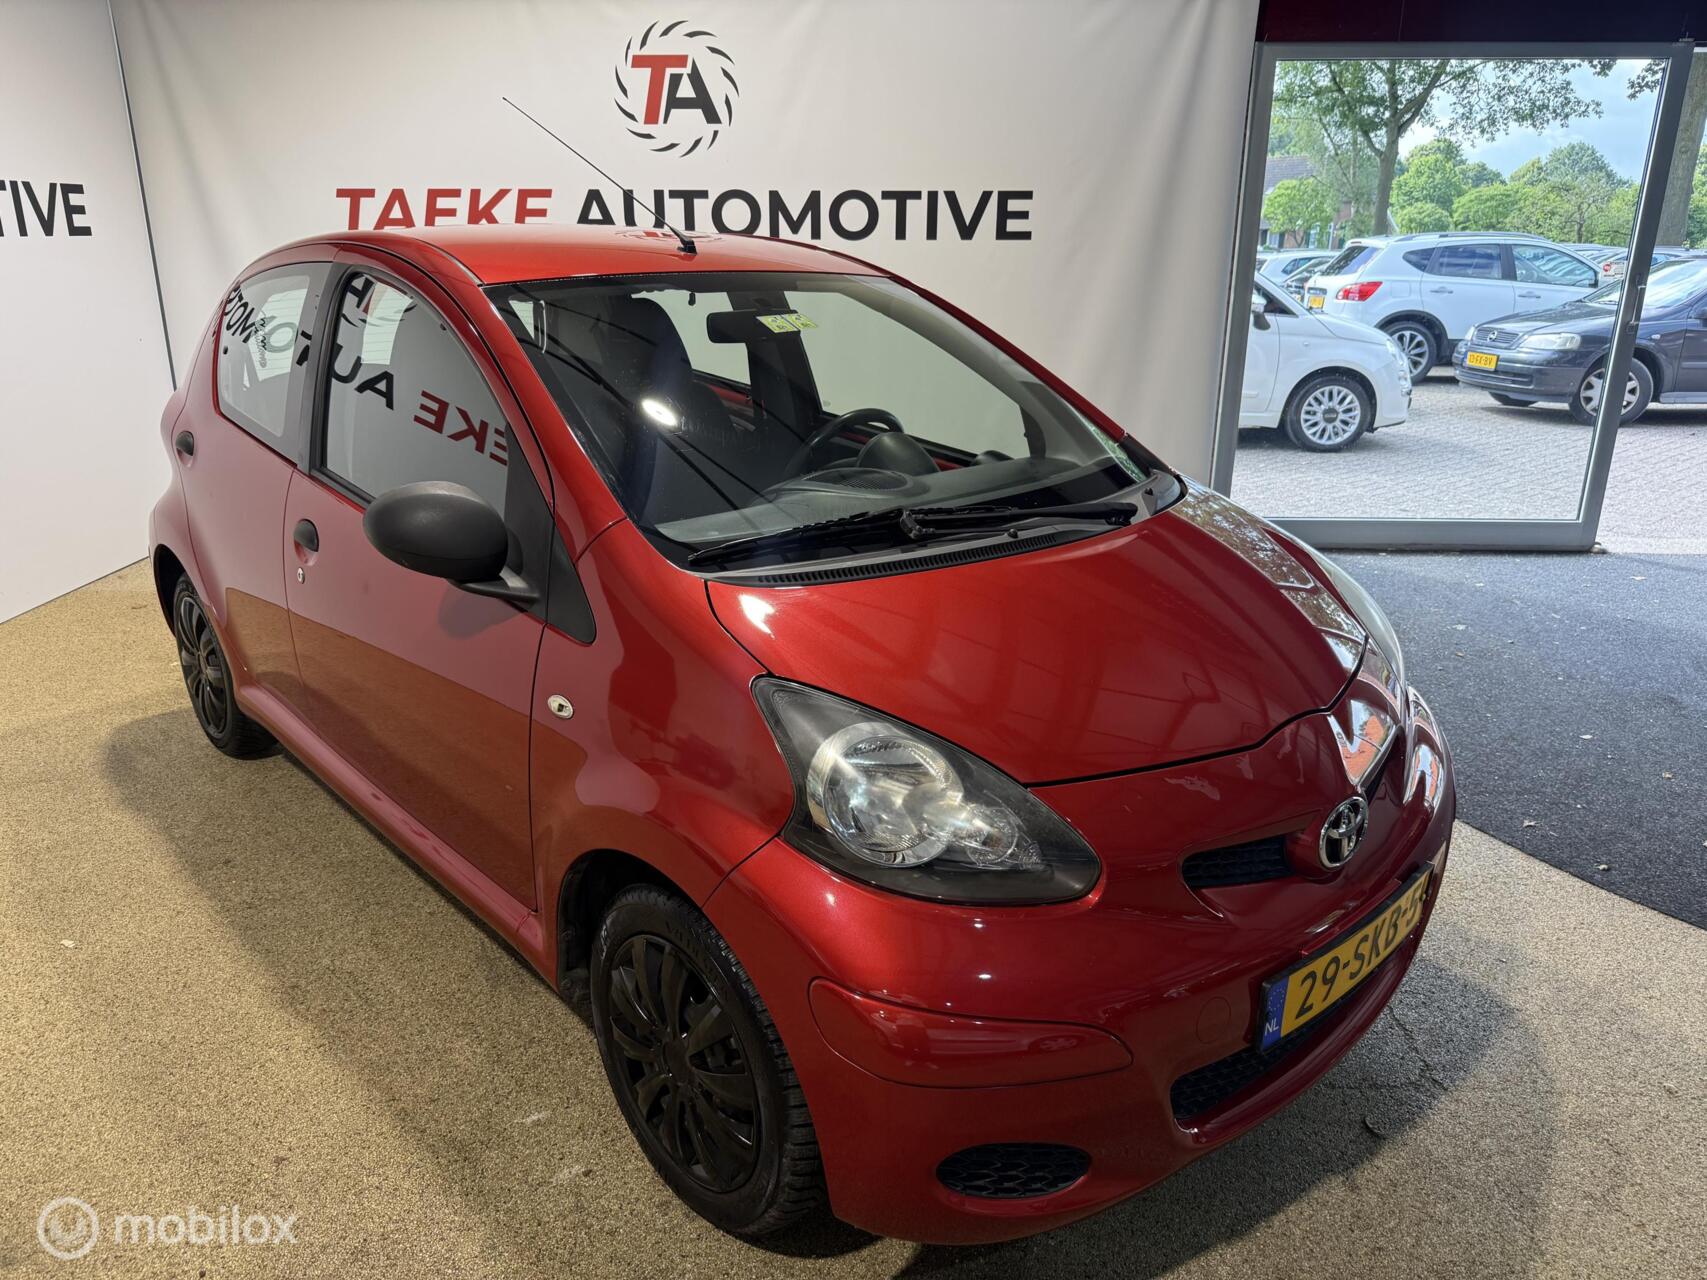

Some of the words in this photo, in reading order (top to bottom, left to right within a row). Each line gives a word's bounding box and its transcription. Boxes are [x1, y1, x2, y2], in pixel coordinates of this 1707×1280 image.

[631, 54, 722, 125] TA
[576, 189, 1034, 241] AUTOMOTIVE
[1295, 881, 1422, 1019] 29-SKB-5
[1264, 1018, 1279, 1036] NL
